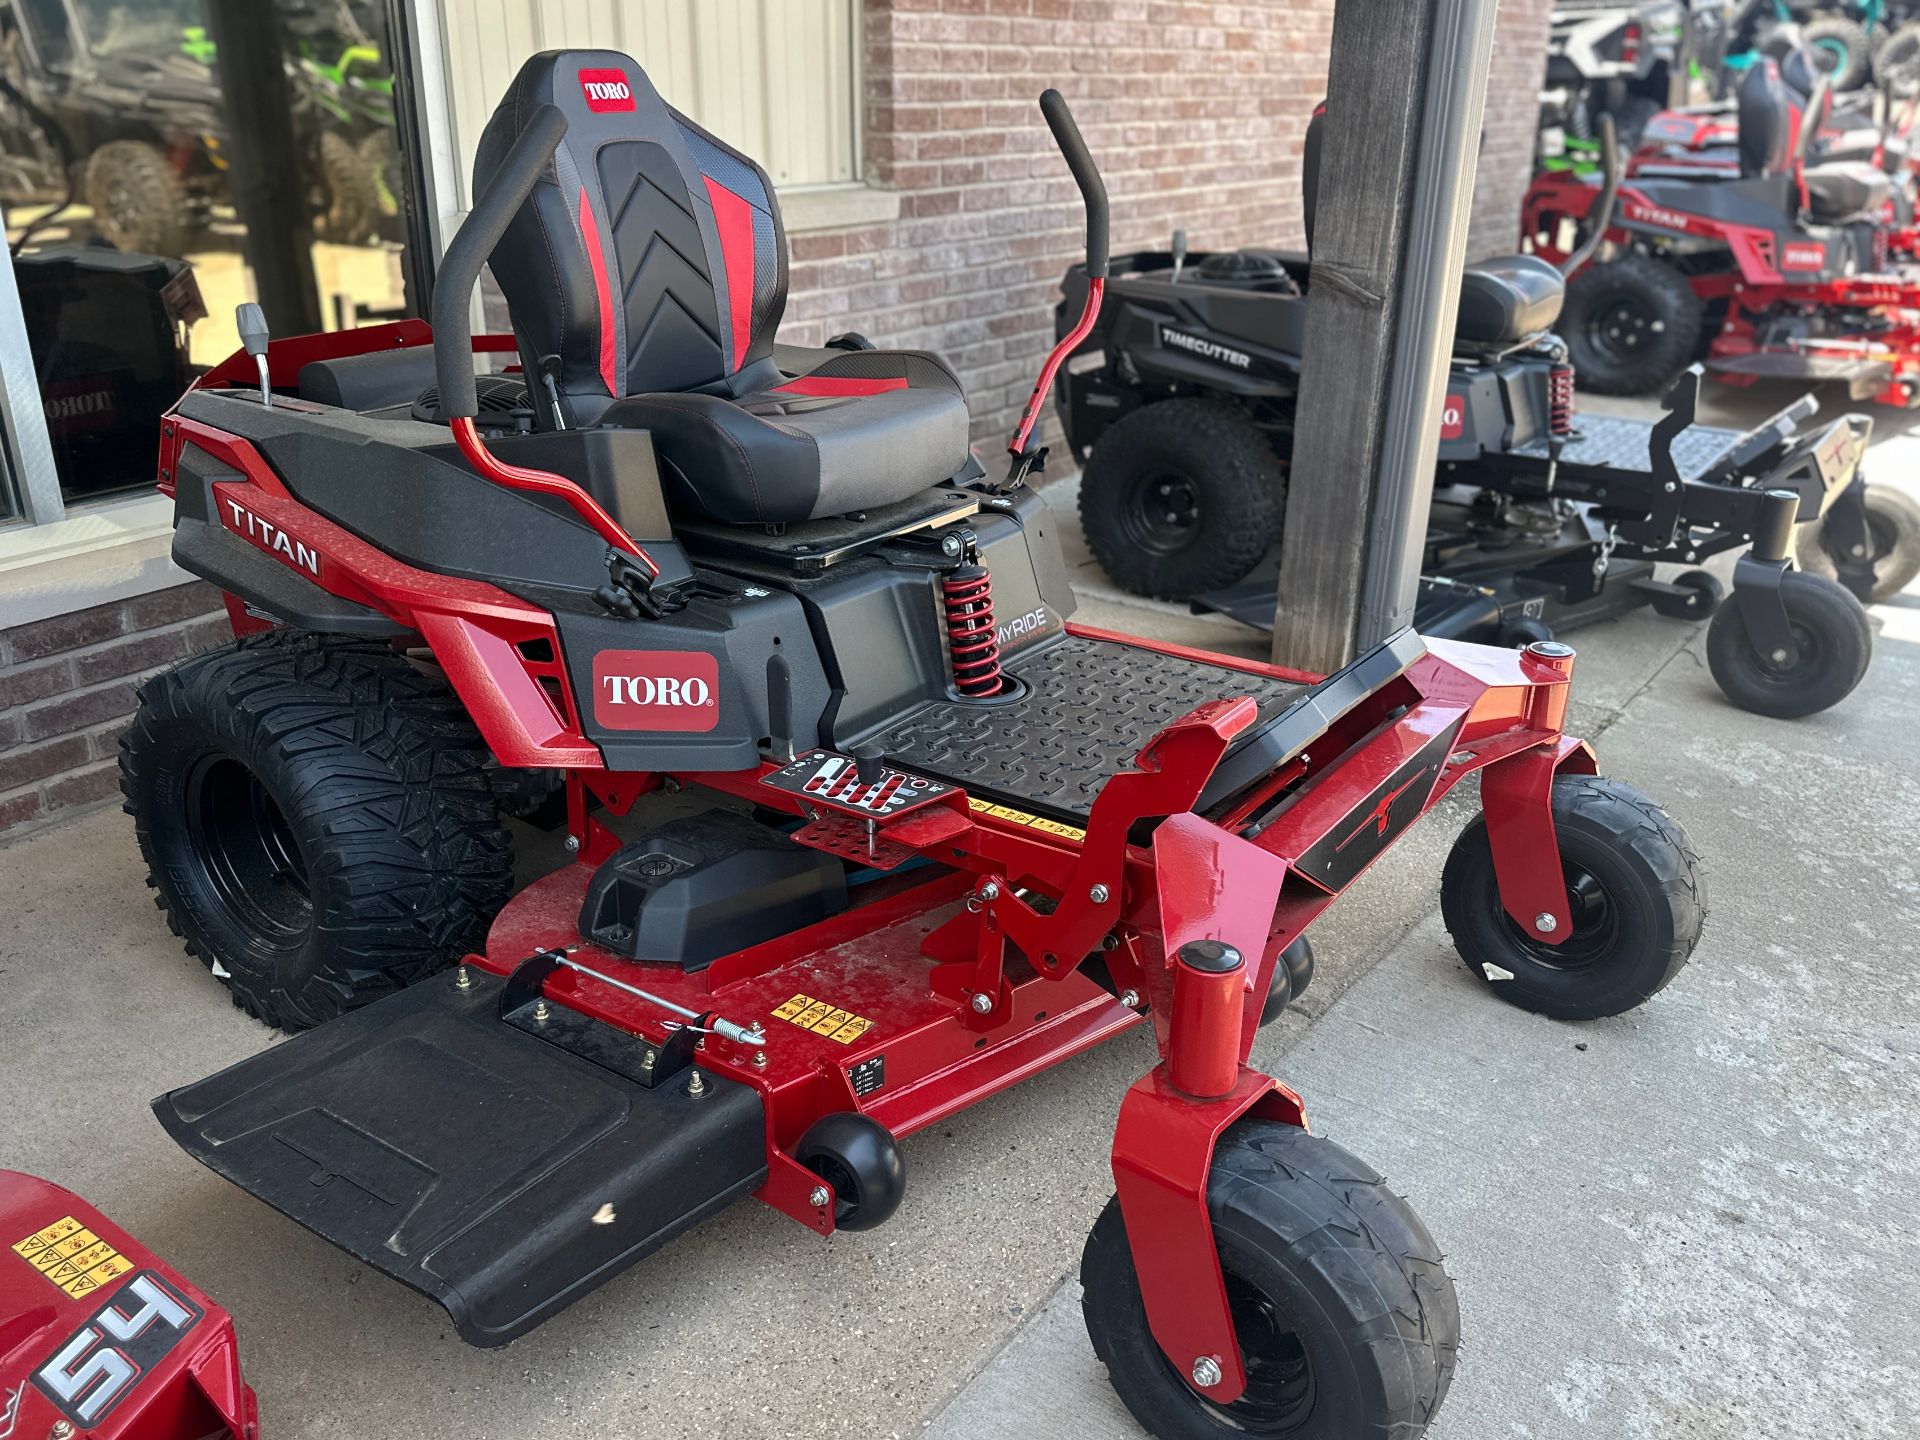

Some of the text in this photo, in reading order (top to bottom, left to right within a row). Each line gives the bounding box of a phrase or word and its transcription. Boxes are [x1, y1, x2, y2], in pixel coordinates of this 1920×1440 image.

[584, 81, 630, 100] TORO
[1162, 328, 1250, 368] TIMECUTTER
[226, 499, 318, 576] TITAN
[603, 675, 709, 706] TORO
[39, 1275, 193, 1421] 54
